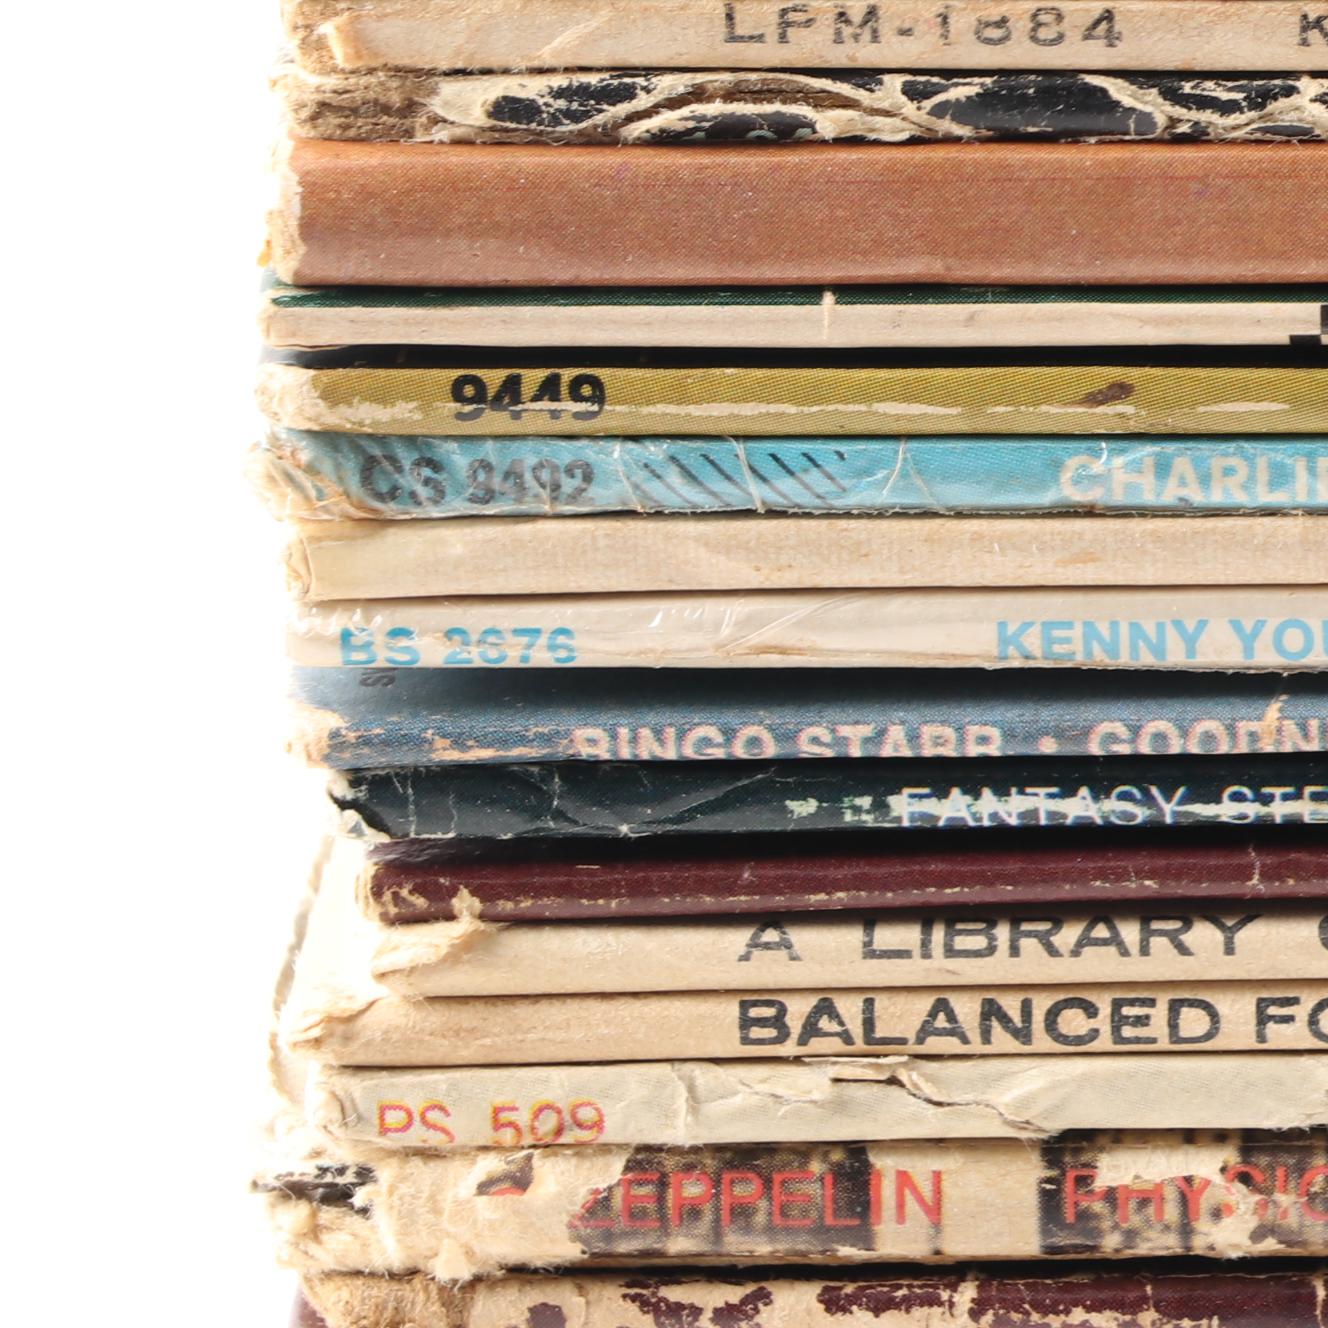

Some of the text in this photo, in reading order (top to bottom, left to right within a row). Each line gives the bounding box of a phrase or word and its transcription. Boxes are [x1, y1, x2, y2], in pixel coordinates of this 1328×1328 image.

[450, 372, 606, 422] 9449
[359, 452, 446, 507] CS
[340, 627, 420, 667] BS
[994, 617, 1210, 663] KENNY
[796, 722, 1003, 759] STARR
[900, 784, 1190, 828] FANTASY
[737, 920, 801, 963] A
[861, 914, 1264, 962] LIBRARY
[738, 996, 1222, 1047] BALANCED
[376, 1097, 607, 1145] PS 509
[567, 1170, 944, 1229] ZEPPELIN
